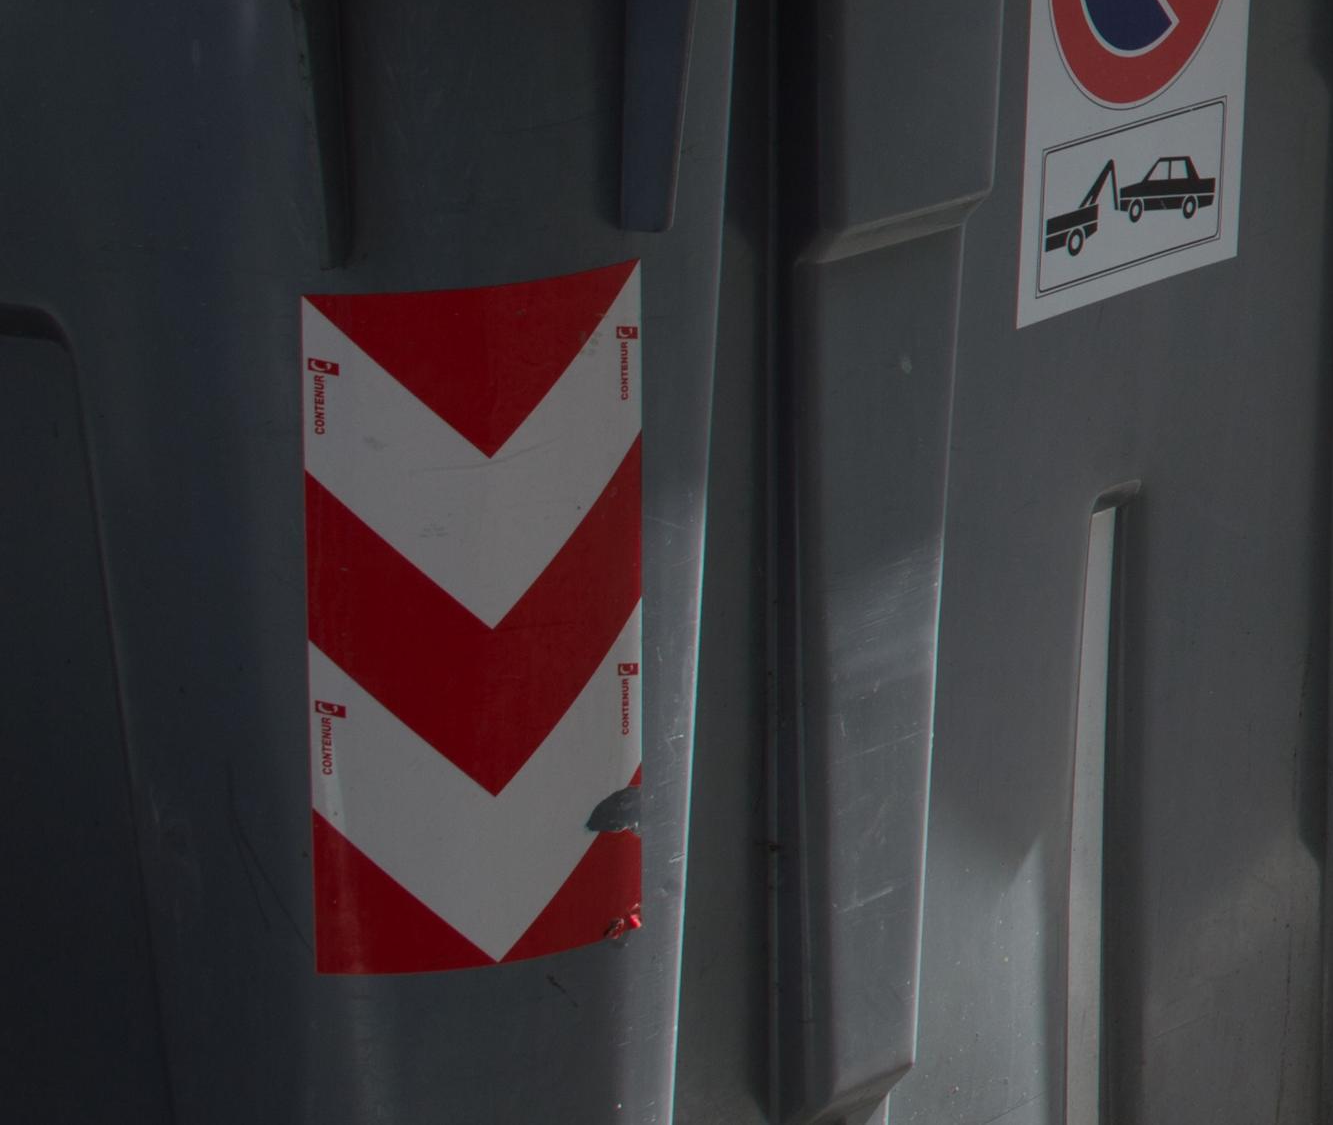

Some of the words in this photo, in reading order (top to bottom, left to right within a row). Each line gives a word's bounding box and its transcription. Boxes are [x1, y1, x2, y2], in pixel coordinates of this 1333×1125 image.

[620, 341, 628, 401] CONTENUR
[314, 374, 325, 435] CONTENUR
[621, 678, 629, 735] CONTENUR
[322, 717, 333, 776] CONTENUR
